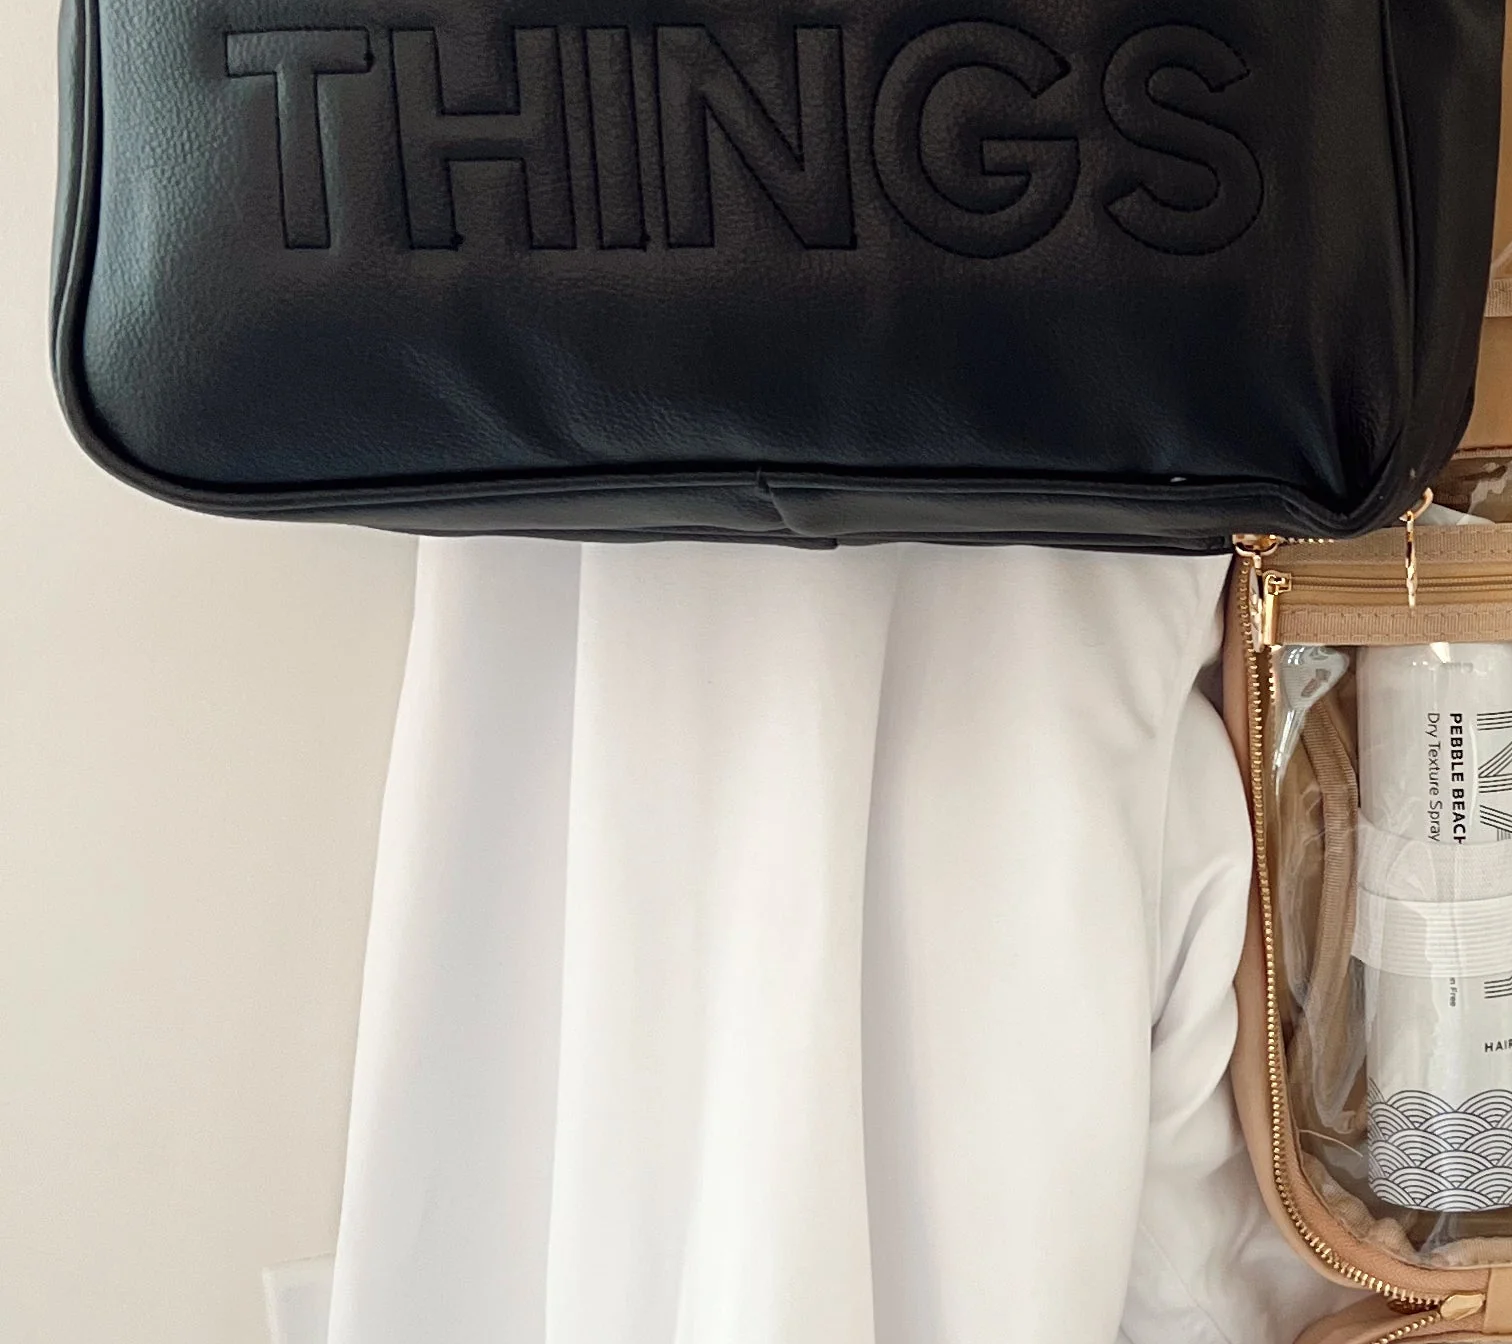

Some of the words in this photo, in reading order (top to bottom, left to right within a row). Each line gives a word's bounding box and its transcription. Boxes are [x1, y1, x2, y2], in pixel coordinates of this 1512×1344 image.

[226, 20, 1264, 254] THINGS
[1425, 712, 1441, 738] Dry
[1450, 713, 1465, 783] PEBBLE
[1428, 740, 1441, 796] Texture
[1427, 800, 1443, 842] Spray
